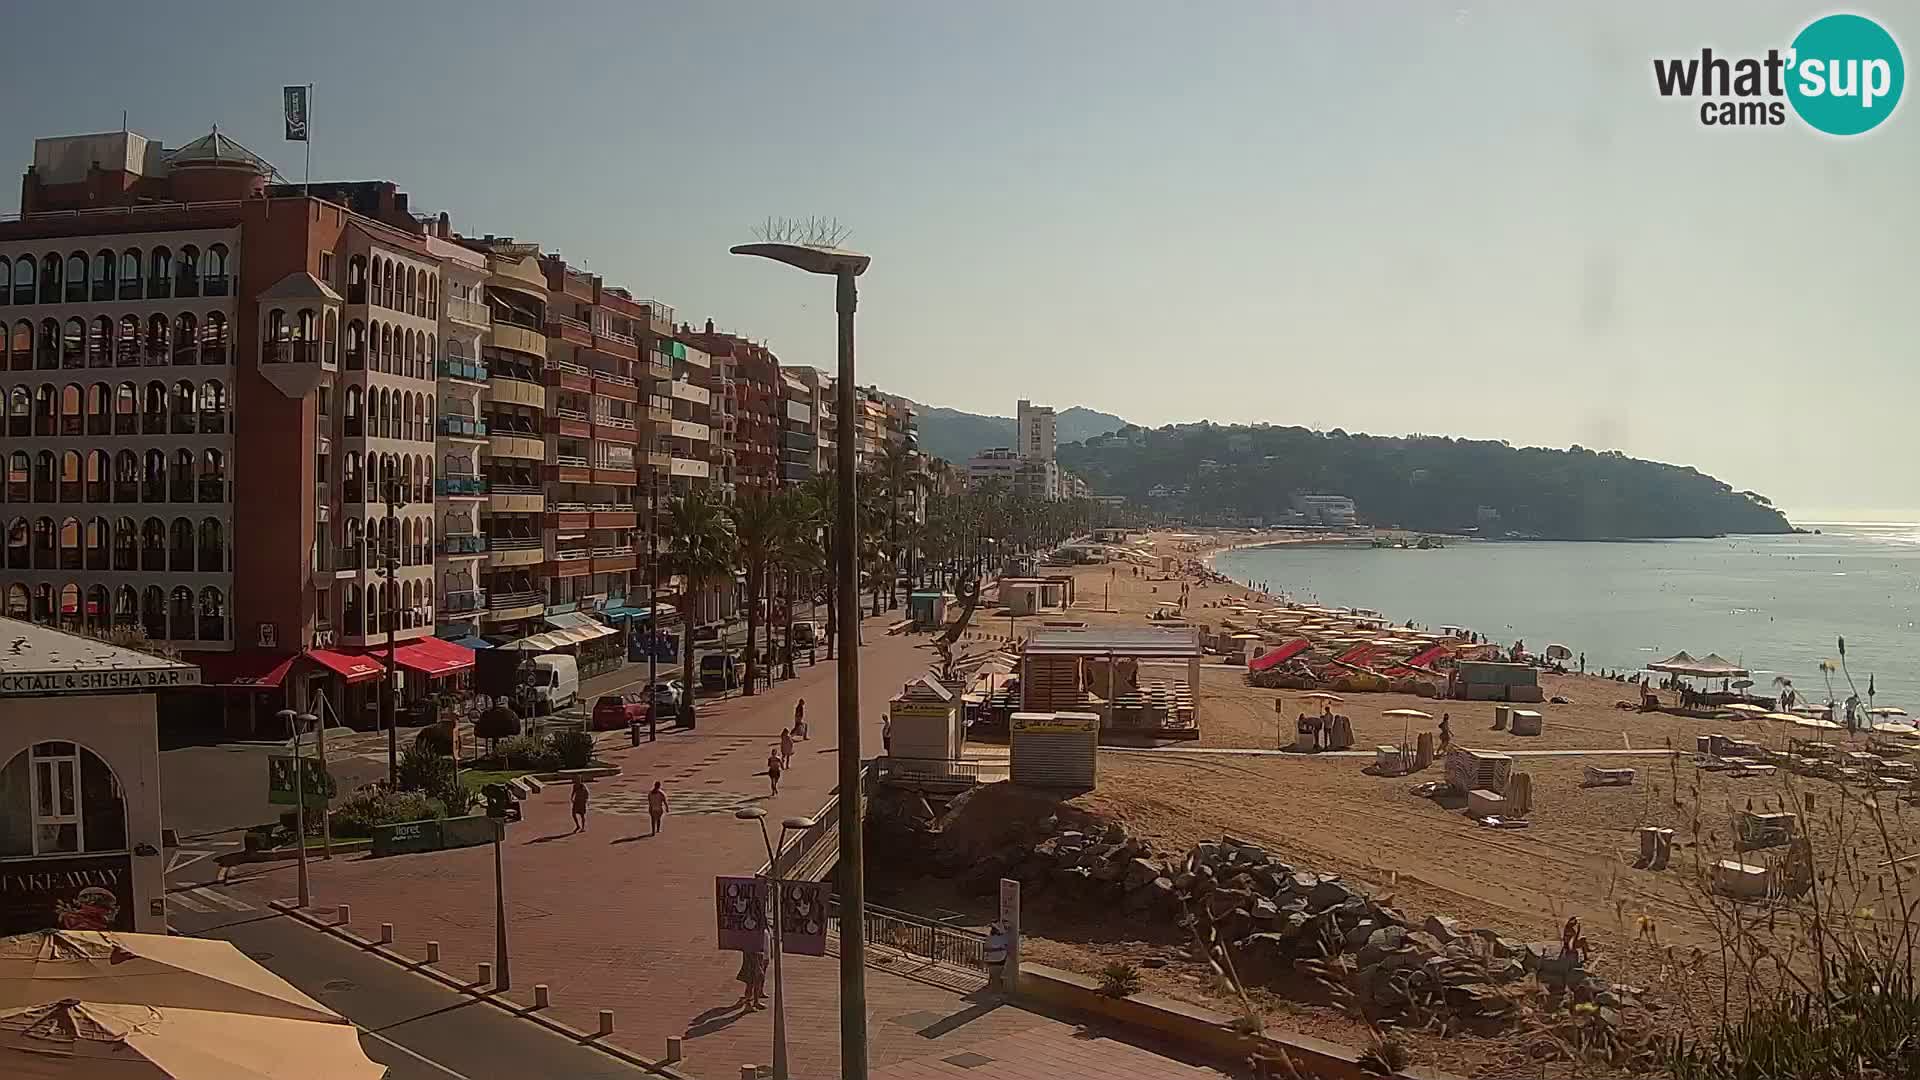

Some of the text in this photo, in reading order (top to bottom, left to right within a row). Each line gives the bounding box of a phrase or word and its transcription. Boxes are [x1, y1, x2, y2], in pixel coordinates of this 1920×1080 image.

[315, 630, 334, 648] KFC
[64, 674, 77, 688] &
[79, 672, 142, 688] SHISHA
[148, 671, 180, 685] BAR
[0, 868, 122, 891] TAKEAWAY
